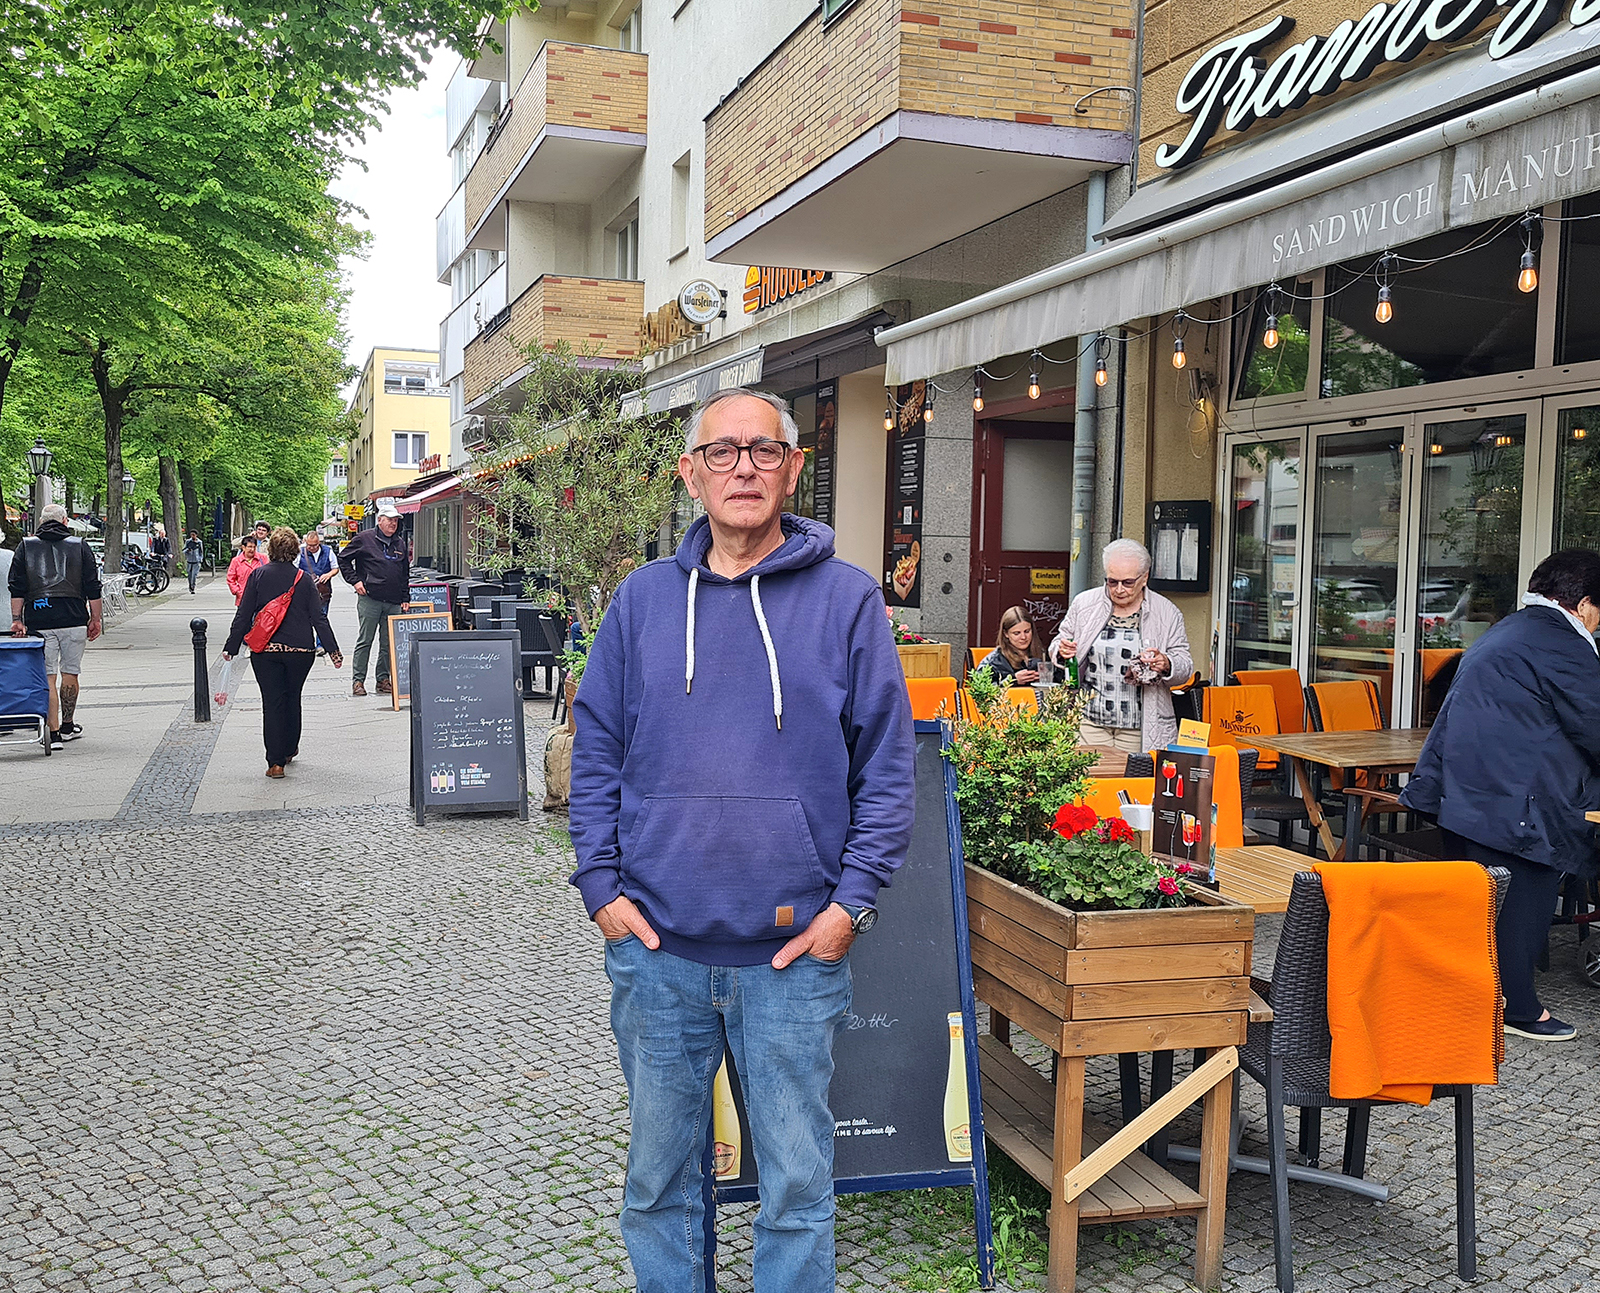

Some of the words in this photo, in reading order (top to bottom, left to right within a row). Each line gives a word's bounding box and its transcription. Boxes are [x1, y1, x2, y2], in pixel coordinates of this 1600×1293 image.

[1154, 0, 1600, 169] Trame
[1271, 182, 1436, 264] SANDWICH
[684, 295, 719, 308] Warsteiner
[398, 620, 448, 632] BUSINESS
[847, 1014, 866, 1030] 20
[834, 1120, 851, 1131] your
[853, 1128, 861, 1136] to
